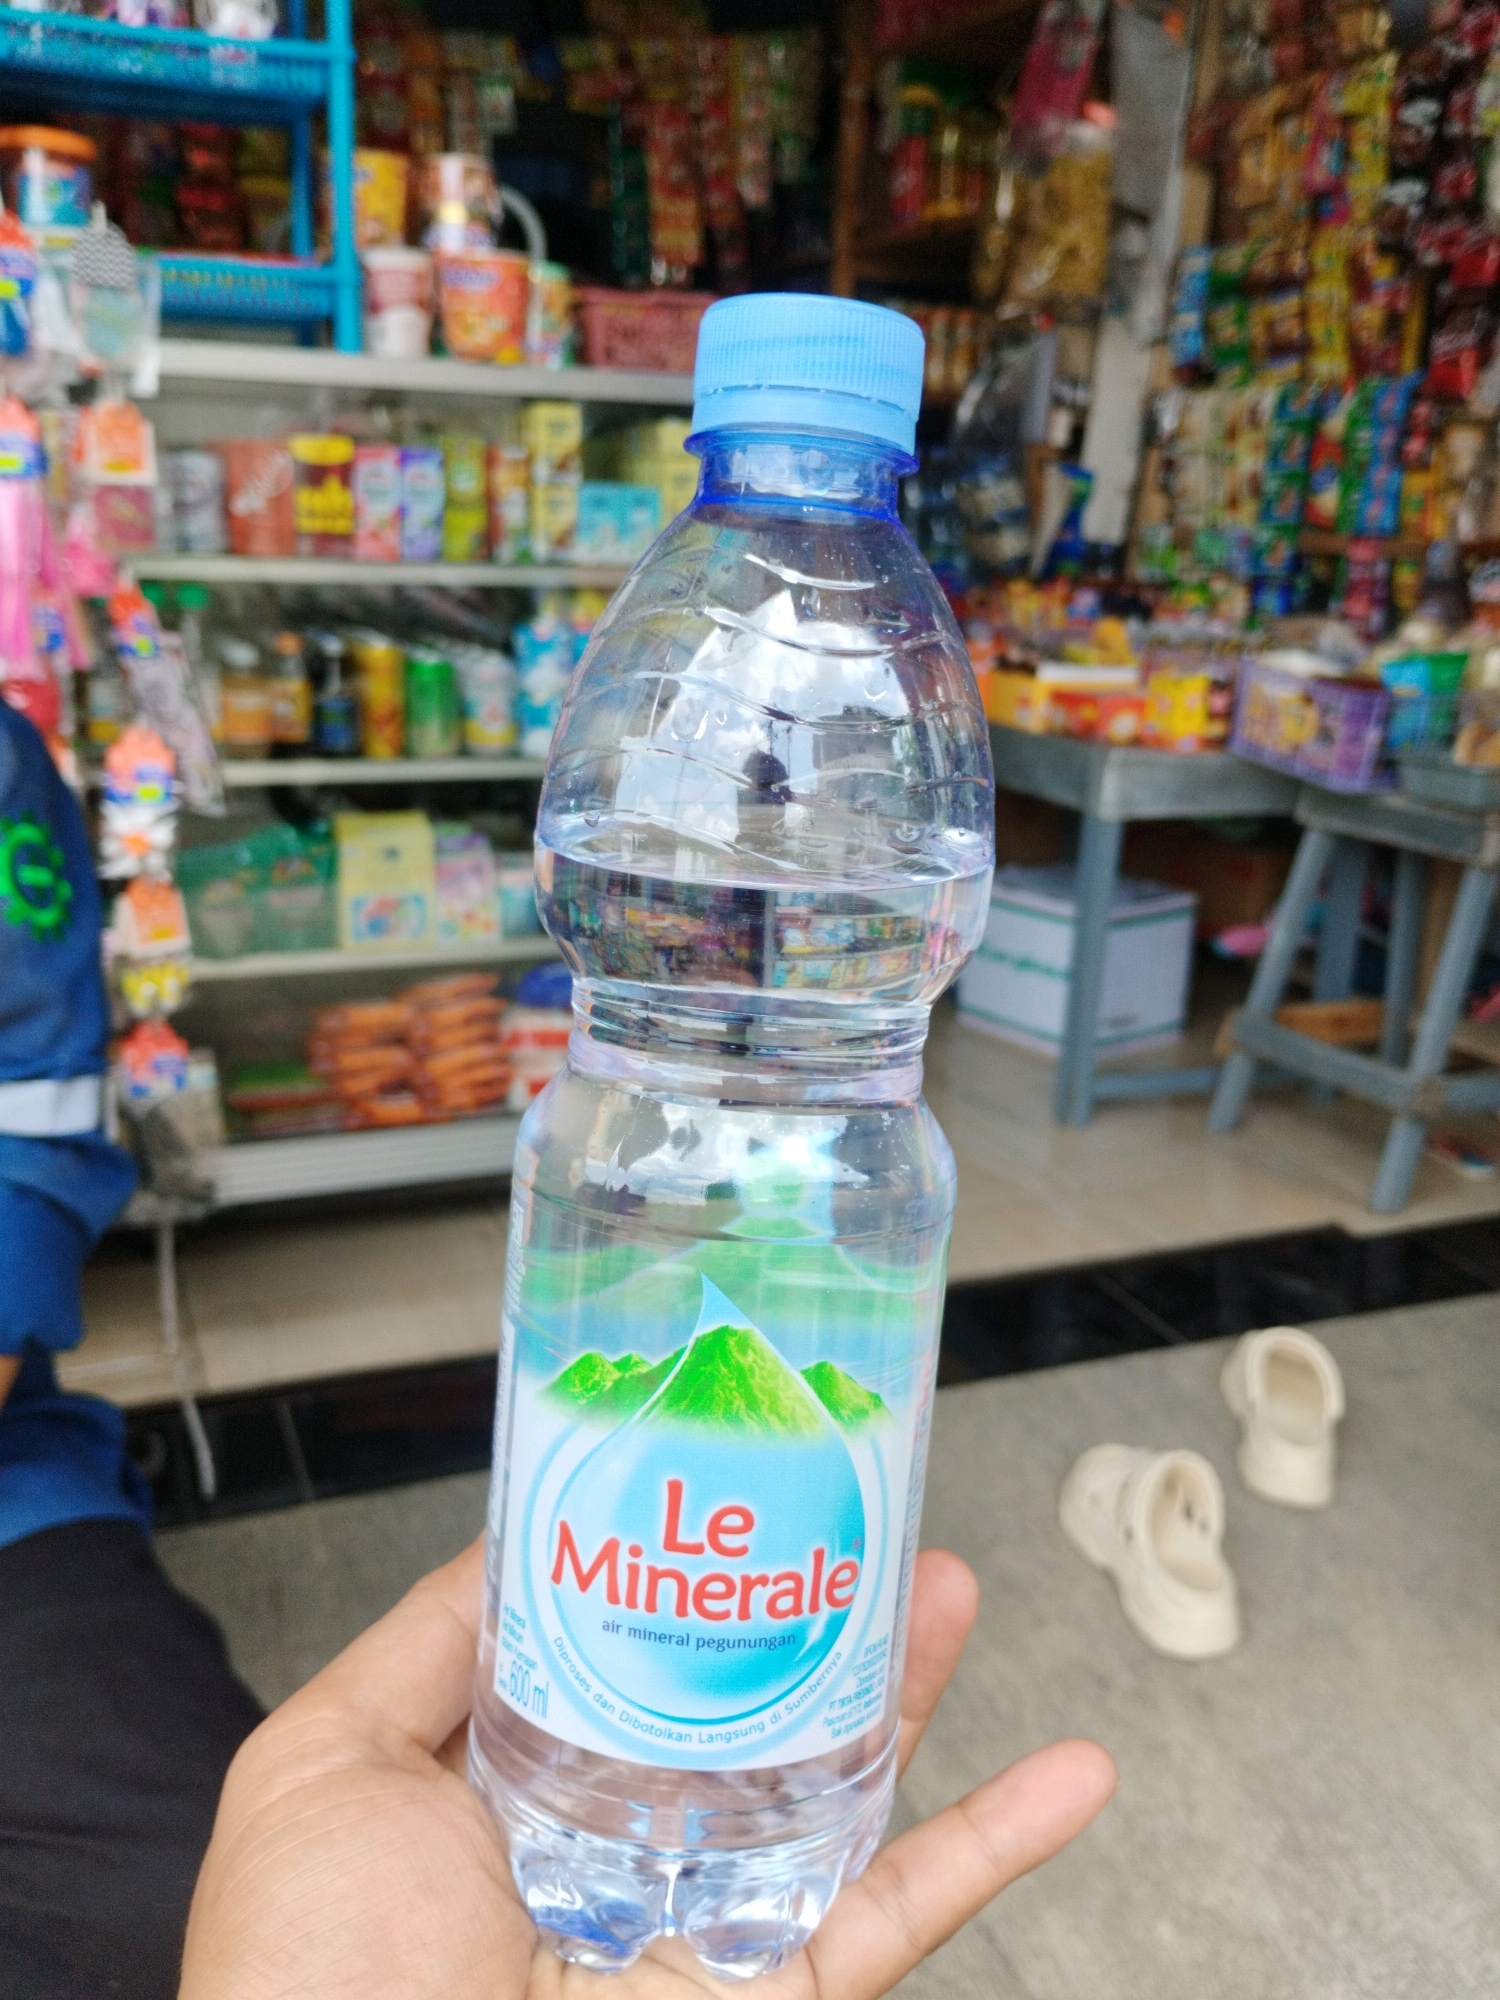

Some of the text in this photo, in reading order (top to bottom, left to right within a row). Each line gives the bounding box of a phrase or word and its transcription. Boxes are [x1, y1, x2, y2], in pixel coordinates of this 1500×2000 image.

[663, 1478, 755, 1557] Le
[551, 1519, 859, 1622] Minerale
[602, 1620, 796, 1652] air mineral pegunungan
[509, 1660, 531, 1707] 600
[532, 1681, 549, 1719] ml
[554, 1636, 592, 1693] Diproses
[593, 1692, 616, 1715] dan
[619, 1710, 692, 1743] Dibotolkan
[698, 1720, 766, 1744] Langsung
[769, 1710, 782, 1725] di
[784, 1651, 842, 1715] Sumbernya
